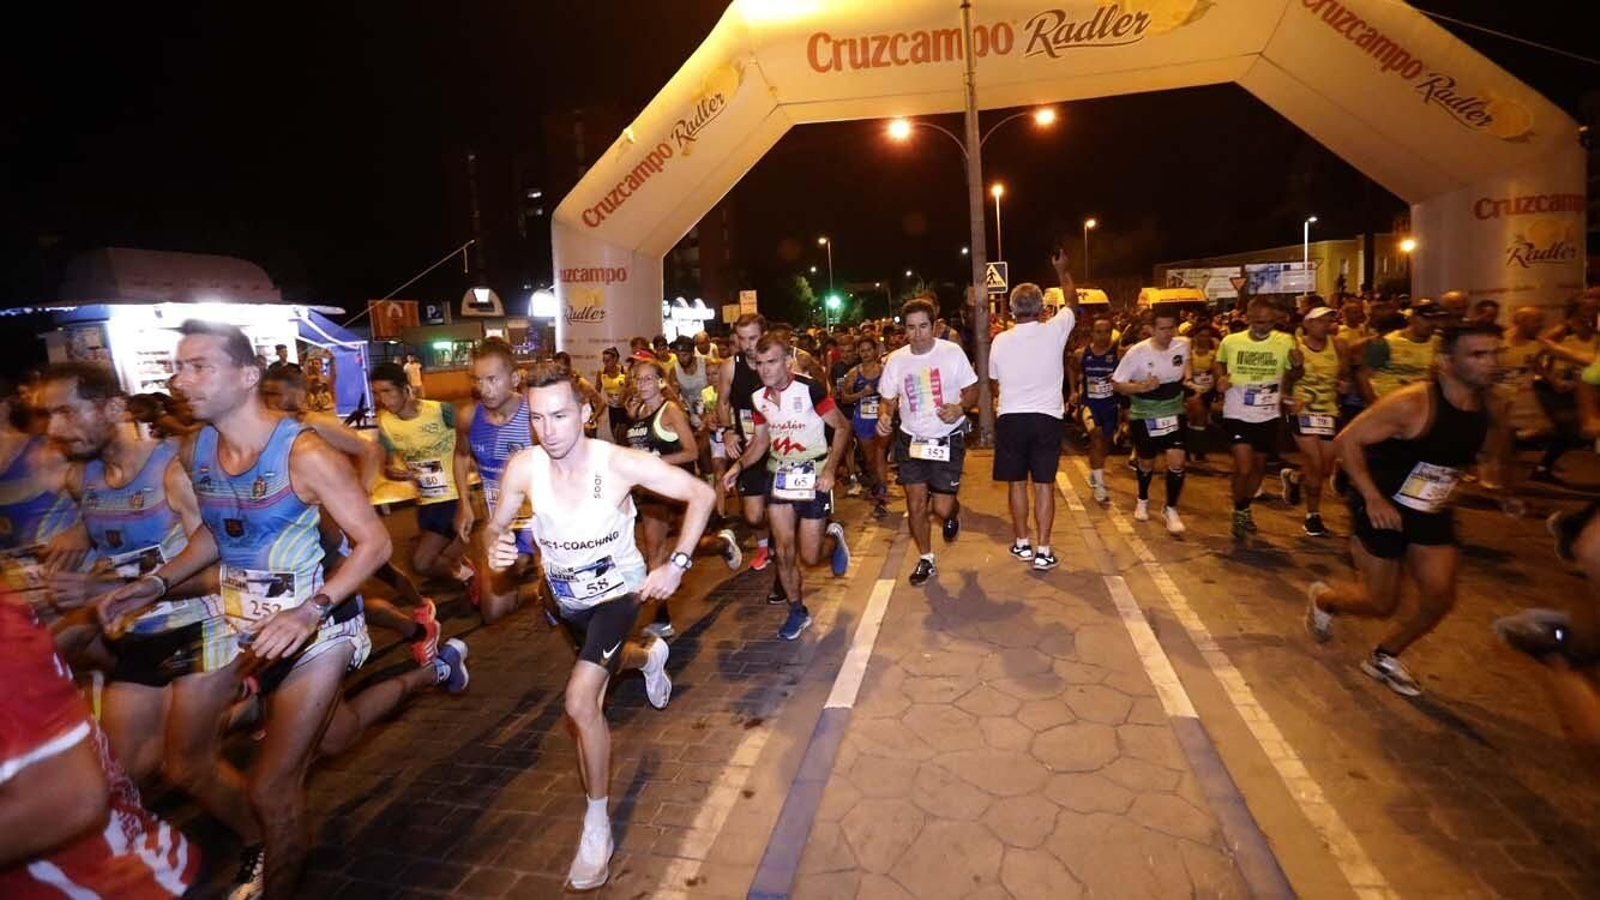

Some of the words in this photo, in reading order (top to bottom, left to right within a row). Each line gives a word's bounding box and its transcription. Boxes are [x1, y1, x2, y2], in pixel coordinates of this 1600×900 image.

[806, 21, 1015, 74] Cruzcampo
[1024, 4, 1152, 58] Radler
[1416, 73, 1494, 129] Radler
[582, 143, 674, 228] Cruzcampo
[671, 93, 727, 148] Radler
[1506, 241, 1576, 268] Radler
[586, 578, 610, 595] 58
